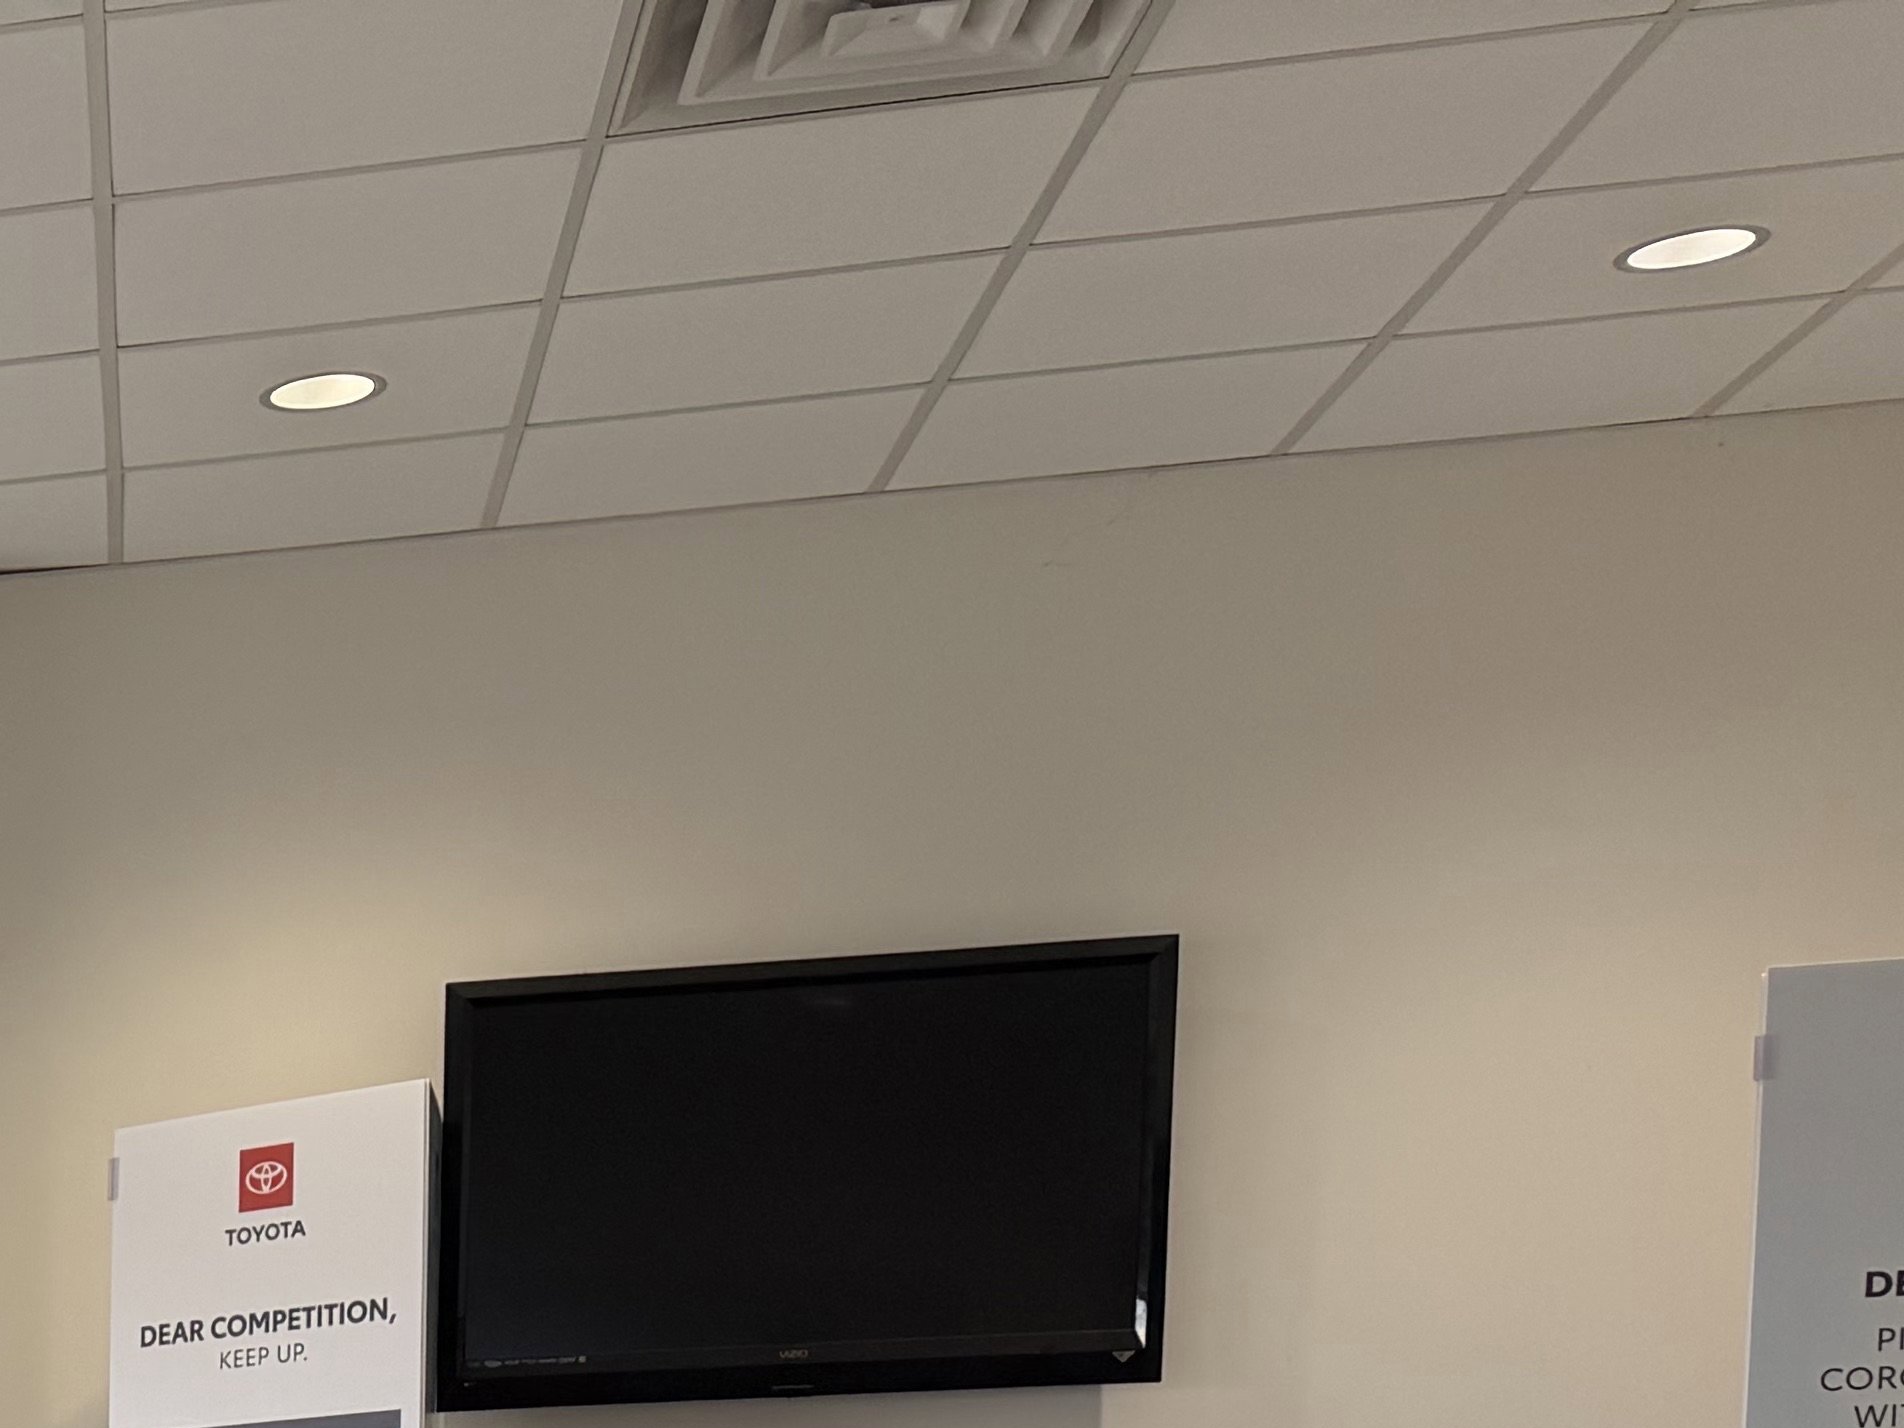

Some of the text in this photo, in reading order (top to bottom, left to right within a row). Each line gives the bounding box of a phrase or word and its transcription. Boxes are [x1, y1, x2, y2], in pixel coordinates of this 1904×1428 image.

[225, 1220, 306, 1246] TOYOTA
[140, 1297, 397, 1348] DEAR COMPETITION,
[219, 1343, 308, 1370] KEEP UP.
[1820, 1366, 1904, 1391] COR
[1854, 1404, 1904, 1428] WI
